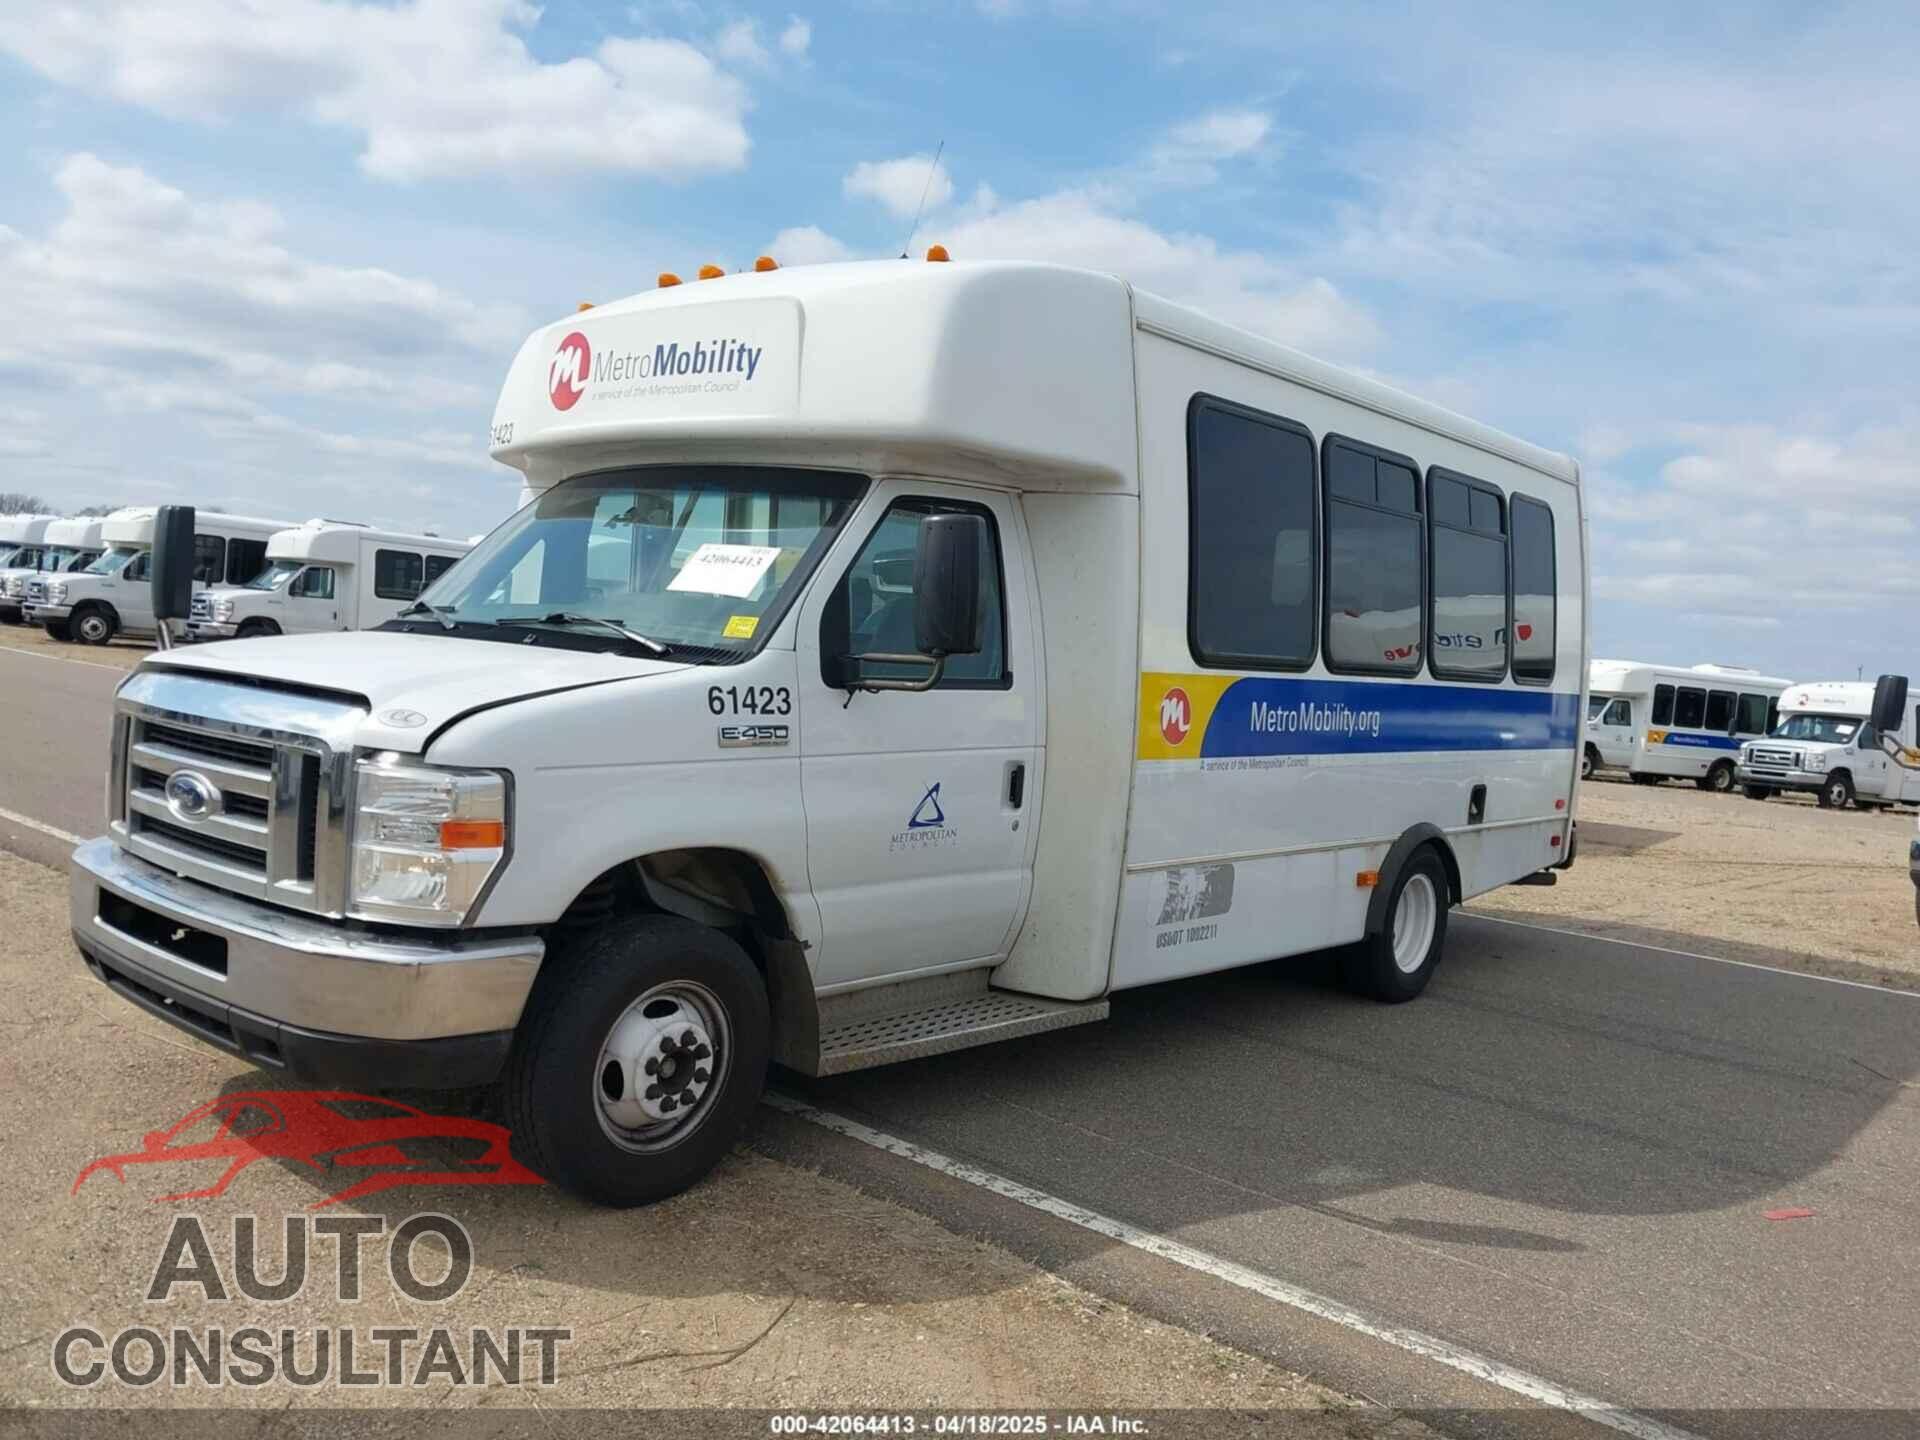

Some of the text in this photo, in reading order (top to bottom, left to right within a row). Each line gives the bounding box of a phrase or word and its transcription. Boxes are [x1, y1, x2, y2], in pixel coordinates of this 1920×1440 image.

[594, 339, 762, 383] MetroMobility
[649, 383, 701, 397] Metropolitan
[704, 380, 740, 392] Council
[708, 686, 792, 715] 61423
[721, 726, 789, 739] E-450
[1207, 761, 1229, 771] service
[1230, 760, 1236, 769] of
[1237, 759, 1248, 769] the
[1249, 757, 1286, 771] Metropolitan
[1287, 756, 1309, 768] Council
[891, 828, 958, 842] METROPOLITAN
[1156, 930, 1184, 949] USDOT
